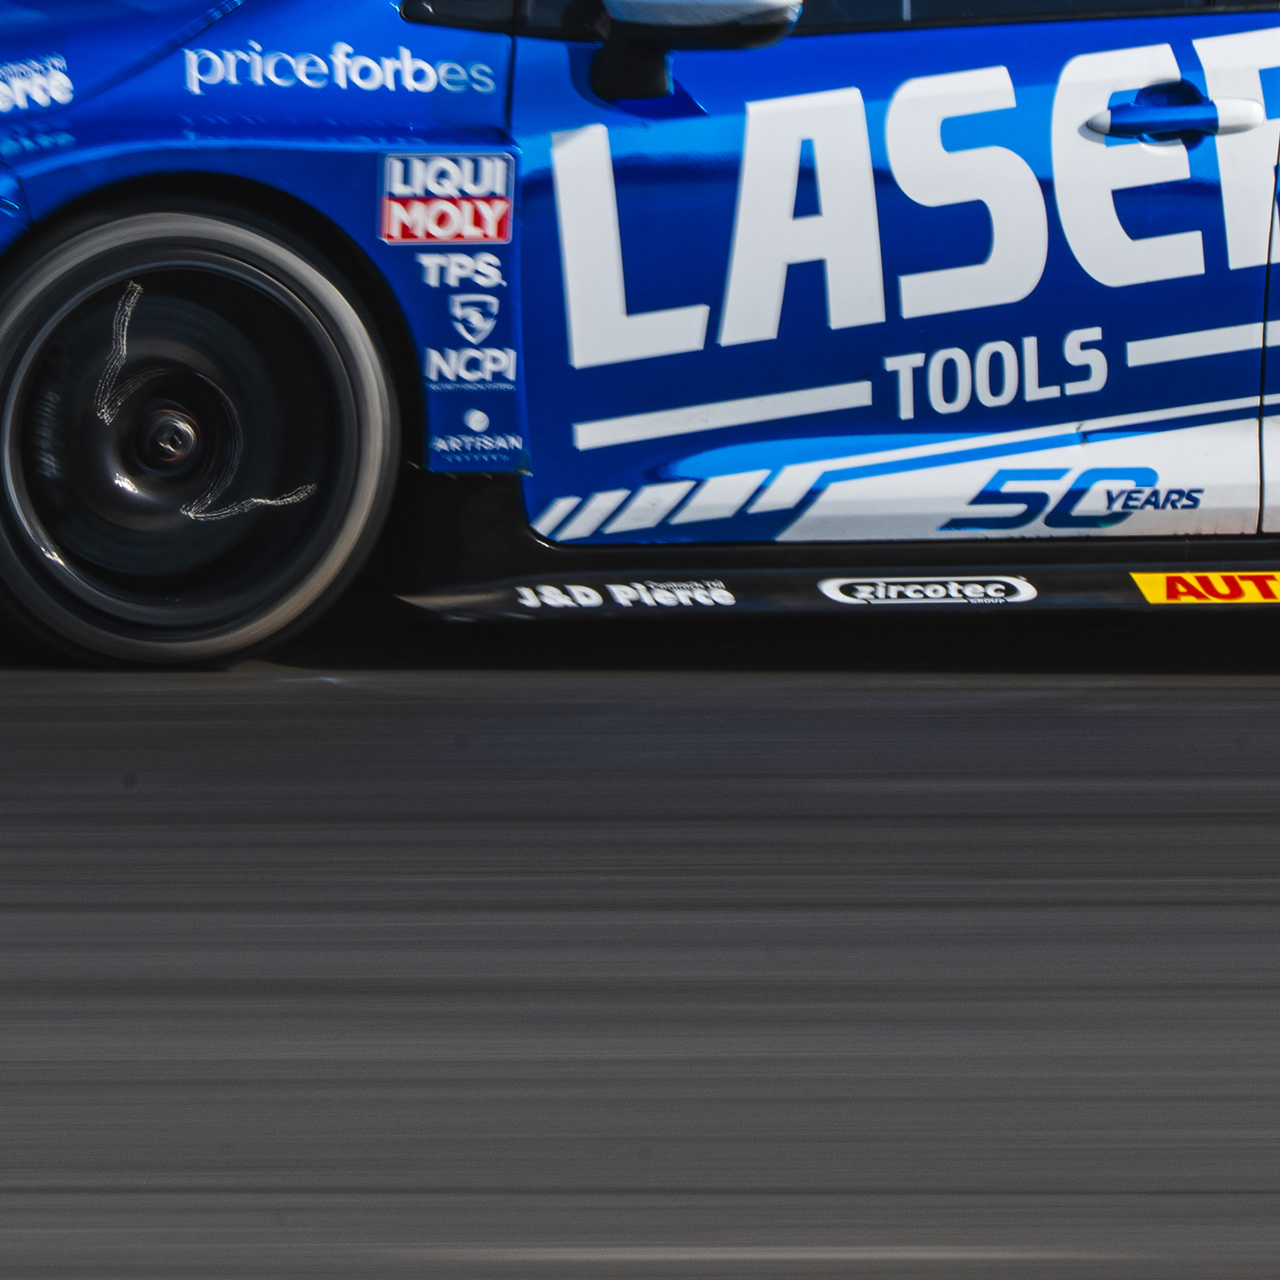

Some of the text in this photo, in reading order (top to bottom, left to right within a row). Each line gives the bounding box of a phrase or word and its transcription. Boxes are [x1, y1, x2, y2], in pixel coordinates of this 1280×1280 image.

[388, 156, 508, 199] LIQUI
[389, 199, 510, 239] MOLY
[424, 346, 517, 382] NCPI
[884, 326, 1109, 421] TOOLS
[937, 466, 1205, 531] 50 YEARS
[515, 582, 736, 608] J&D Pierce
[851, 581, 1006, 599] zircotec
